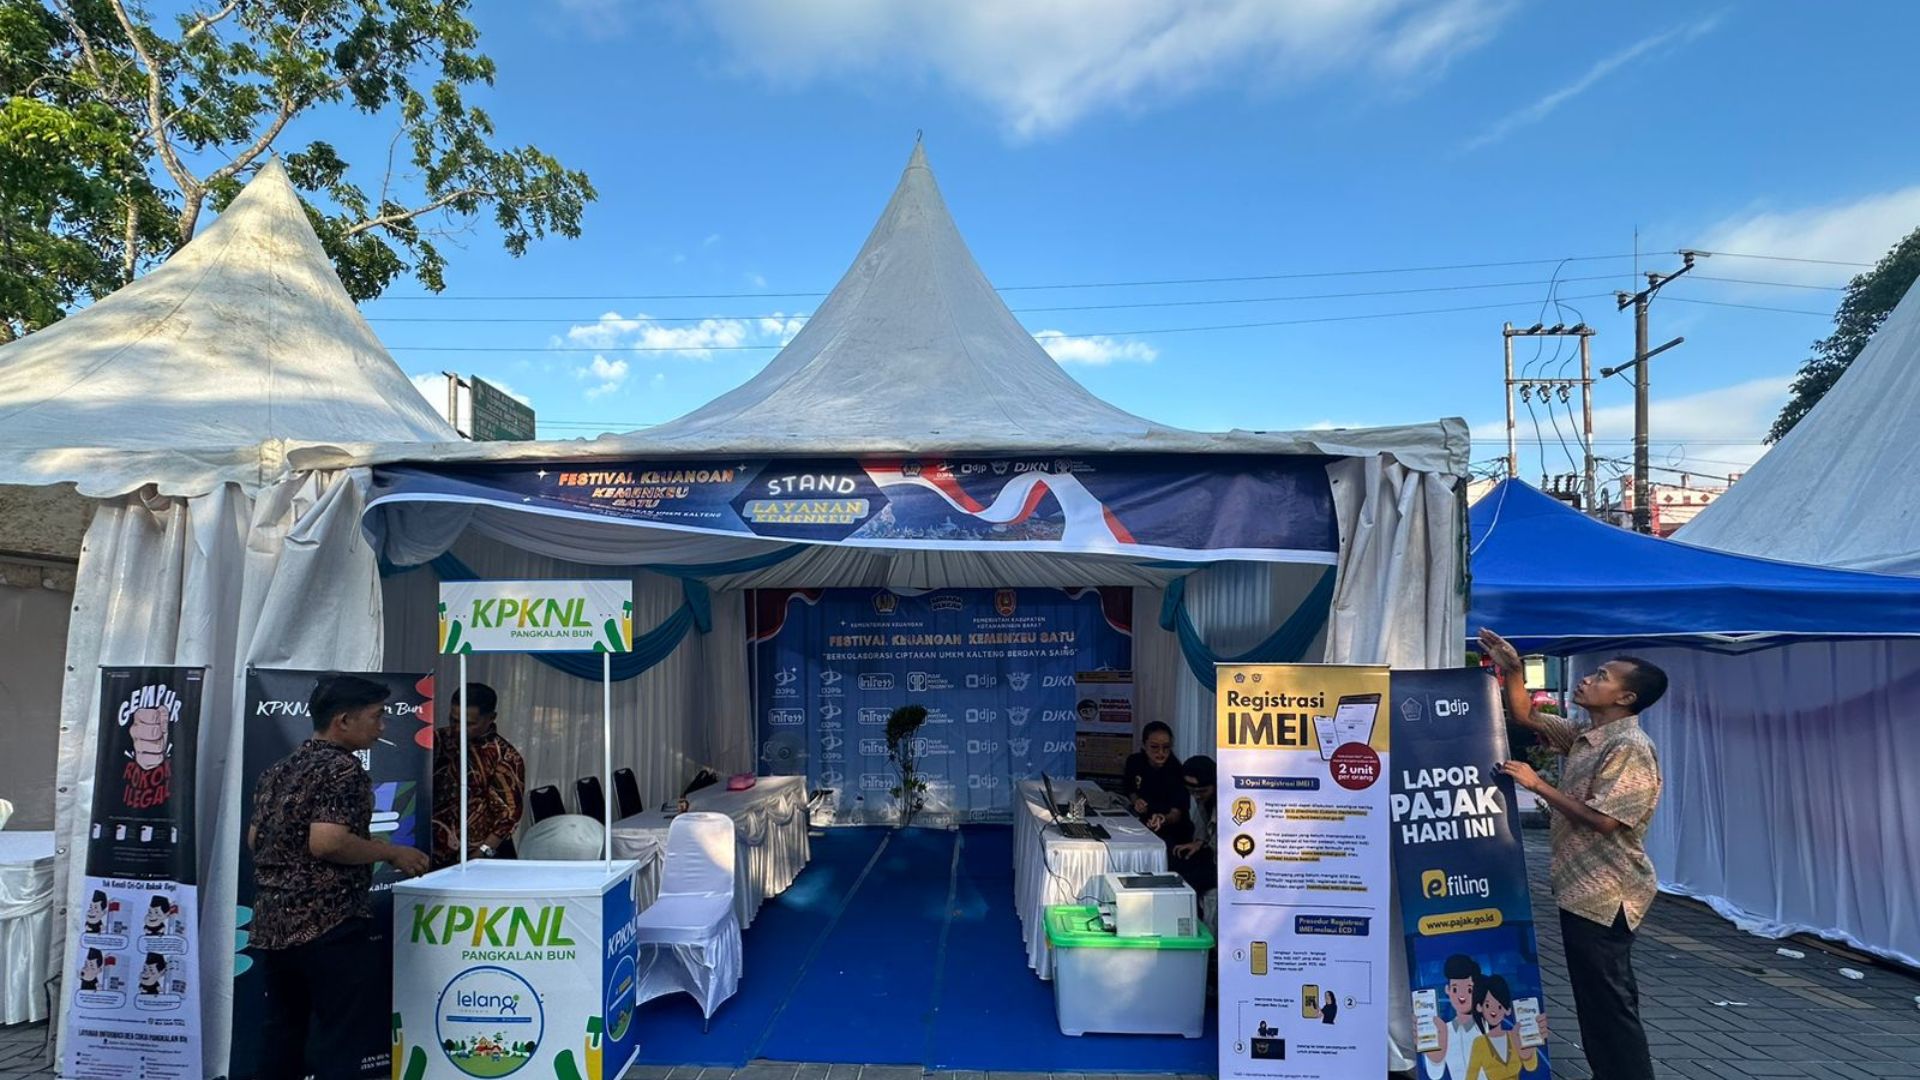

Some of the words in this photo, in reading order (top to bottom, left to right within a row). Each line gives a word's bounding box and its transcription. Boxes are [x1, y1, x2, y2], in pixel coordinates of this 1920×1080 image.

[1014, 462, 1049, 472] DJKN
[559, 472, 635, 487] FESTIVAL
[640, 470, 735, 484] KEUANGAN
[767, 474, 856, 496] STAND
[591, 485, 691, 499] KEMENKEU
[612, 498, 660, 508] SATU
[752, 501, 863, 513] LAYANAN
[755, 514, 852, 523] KEMENKEU
[471, 598, 593, 629] KPKNL
[511, 630, 570, 638] PANGKALAN
[572, 630, 593, 638] BUN
[829, 635, 888, 647] FESTIVAL
[891, 633, 962, 646] KEUANGAN
[968, 632, 1037, 645] KEMENKEU
[1040, 631, 1076, 643] SATU
[940, 651, 965, 659] UMKM
[966, 650, 1005, 658] KALTENG
[1007, 649, 1047, 657] BERDAYA
[979, 675, 997, 687] djp
[118, 683, 182, 727] GEMPUR
[1227, 690, 1325, 711] Registrasi
[1450, 699, 1470, 716] djp
[395, 702, 423, 716] Bun
[979, 708, 997, 723] djp
[1228, 712, 1308, 746] IMEI
[980, 740, 998, 754] djp
[123, 761, 172, 788] ROKOK
[1338, 763, 1349, 774] 2
[1349, 763, 1374, 775] unit
[981, 774, 999, 788] djp
[1245, 779, 1261, 788] Opsi
[1262, 780, 1295, 789] Registrasi
[1403, 765, 1480, 790] LAPOR
[123, 784, 171, 809] ILEGAL
[1390, 786, 1502, 822] PAJAK
[1402, 820, 1459, 845] HARI
[1464, 817, 1496, 838] INI
[411, 903, 576, 947] KPKNL
[1330, 918, 1365, 926] Registrasi
[1426, 913, 1495, 930] www.pajak.go.id
[461, 951, 543, 960] PANGKALAN
[546, 950, 576, 960] BUN
